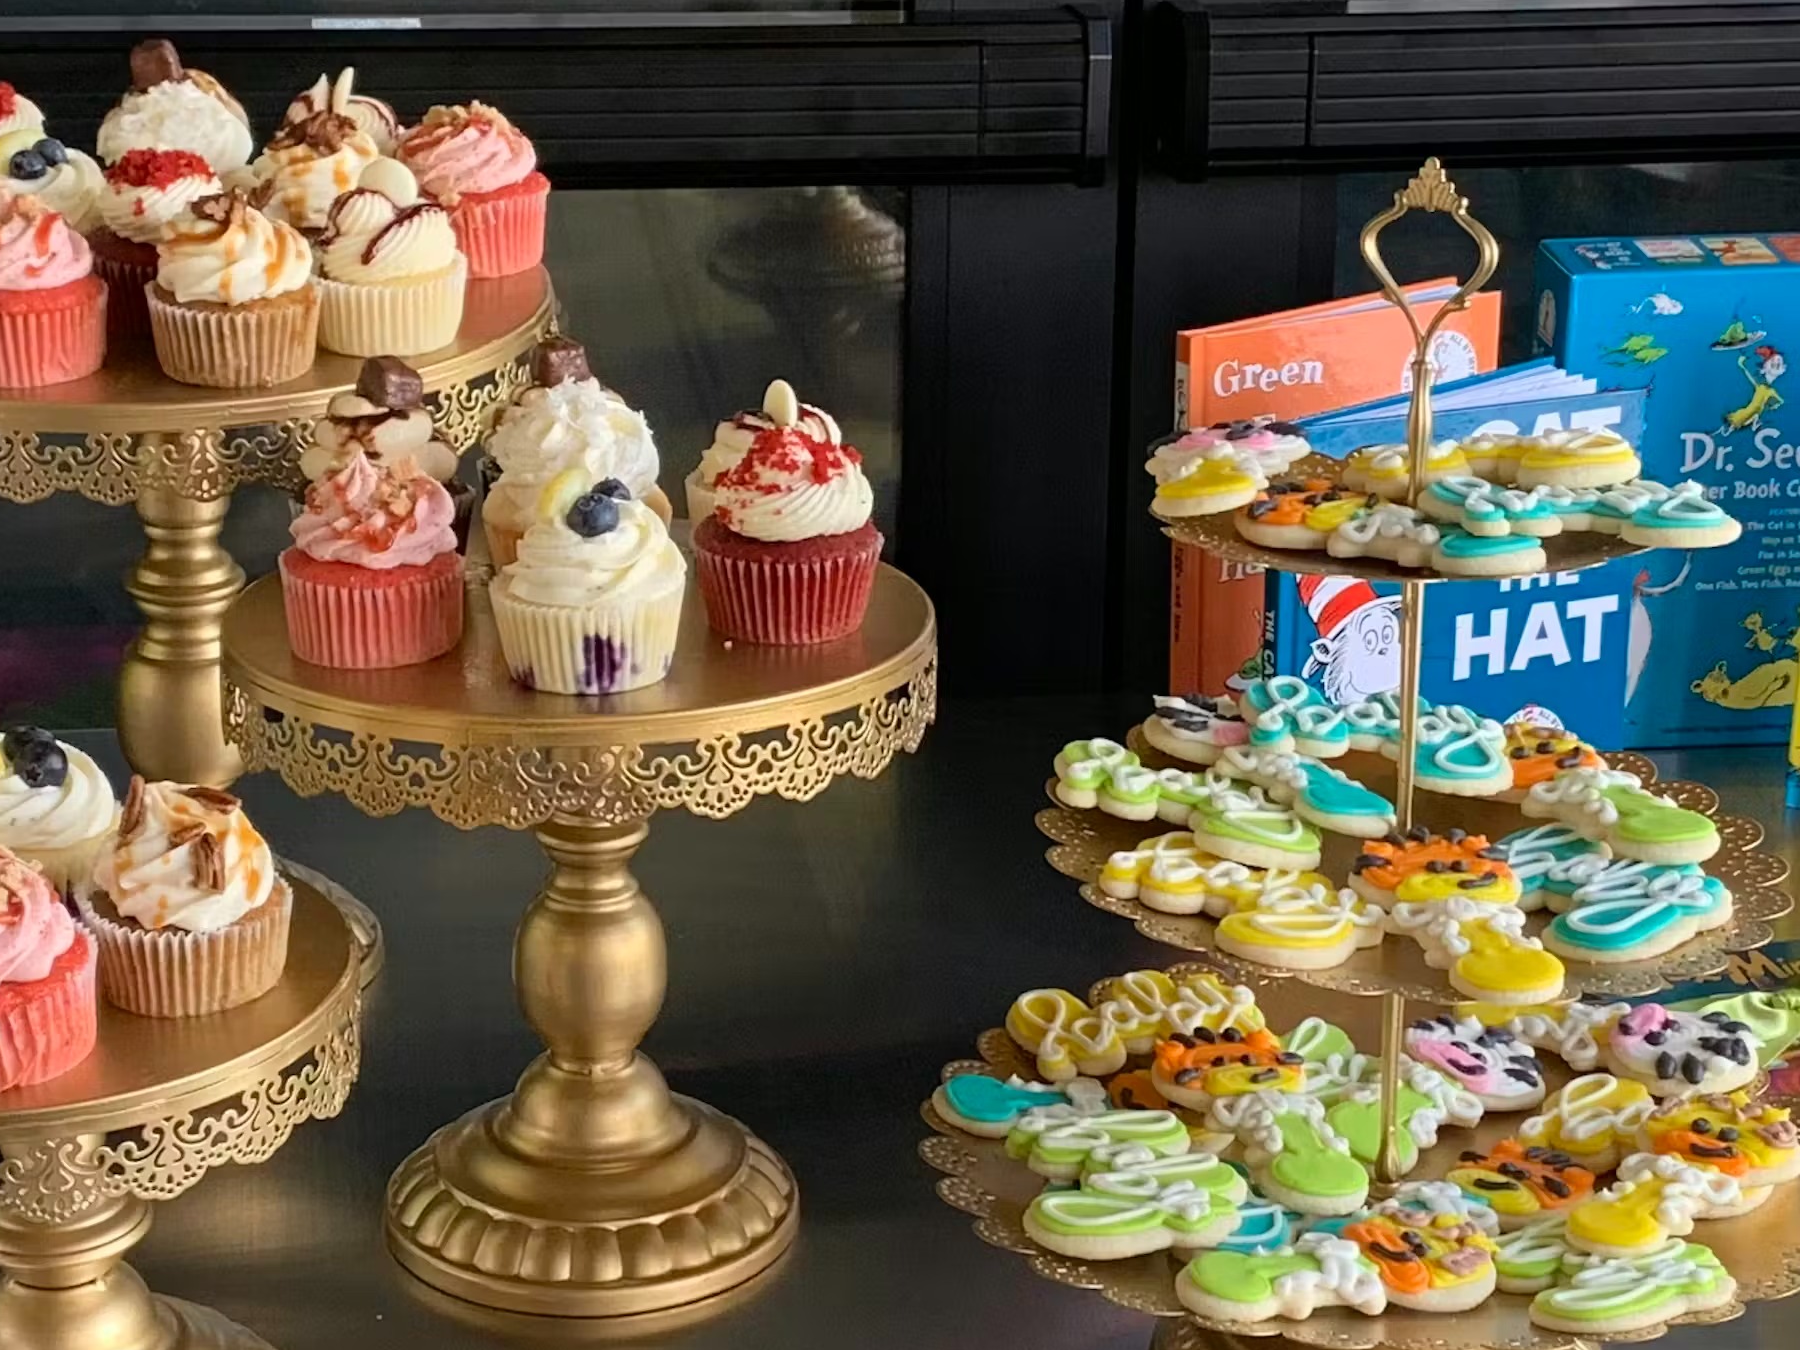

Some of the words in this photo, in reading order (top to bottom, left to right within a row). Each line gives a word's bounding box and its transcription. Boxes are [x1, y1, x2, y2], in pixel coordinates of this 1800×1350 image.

[1212, 356, 1325, 398] Green
[1679, 431, 1735, 474] Dr.
[1733, 477, 1781, 499] Book
[1264, 609, 1276, 642] THE
[1452, 593, 1620, 682] HAT
